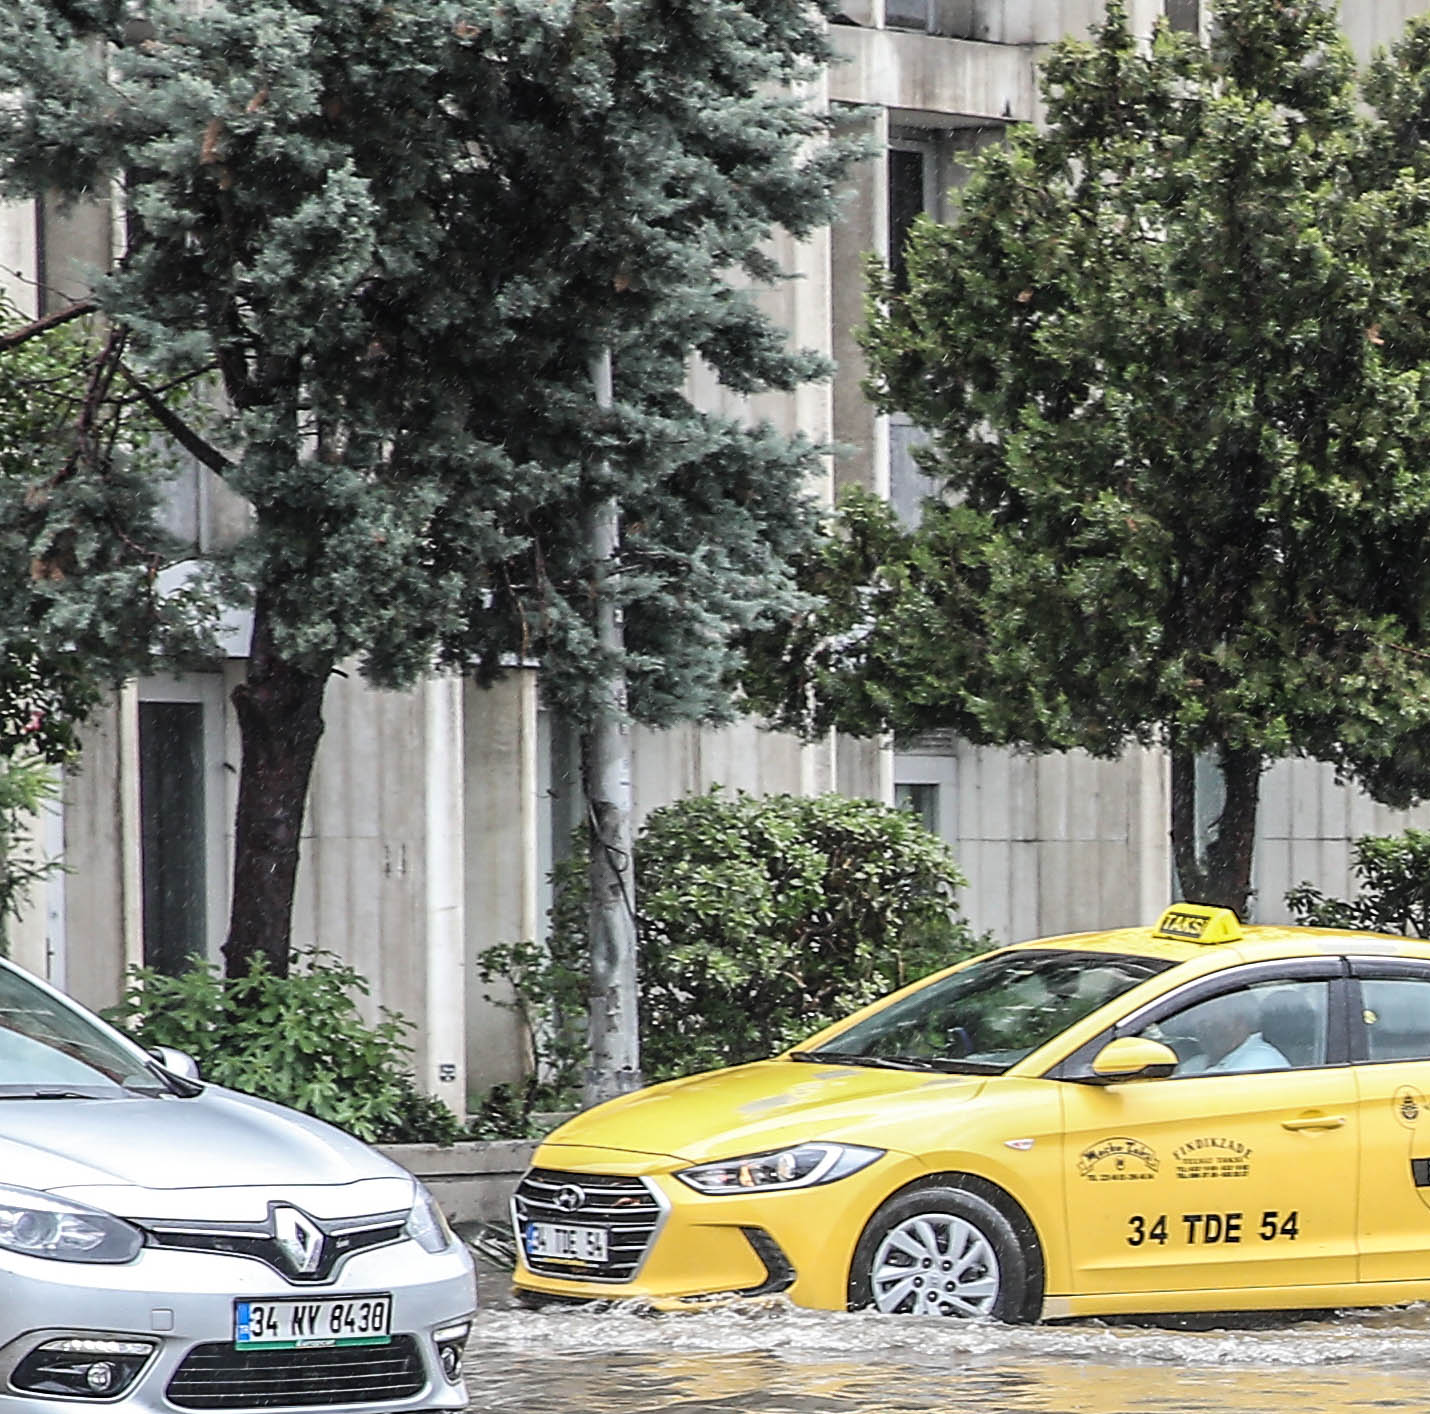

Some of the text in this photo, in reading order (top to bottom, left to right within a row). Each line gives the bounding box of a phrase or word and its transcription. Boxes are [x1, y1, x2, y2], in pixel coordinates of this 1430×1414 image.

[1127, 1211, 1299, 1246] 34 TDE 54
[252, 1306, 277, 1337] 34
